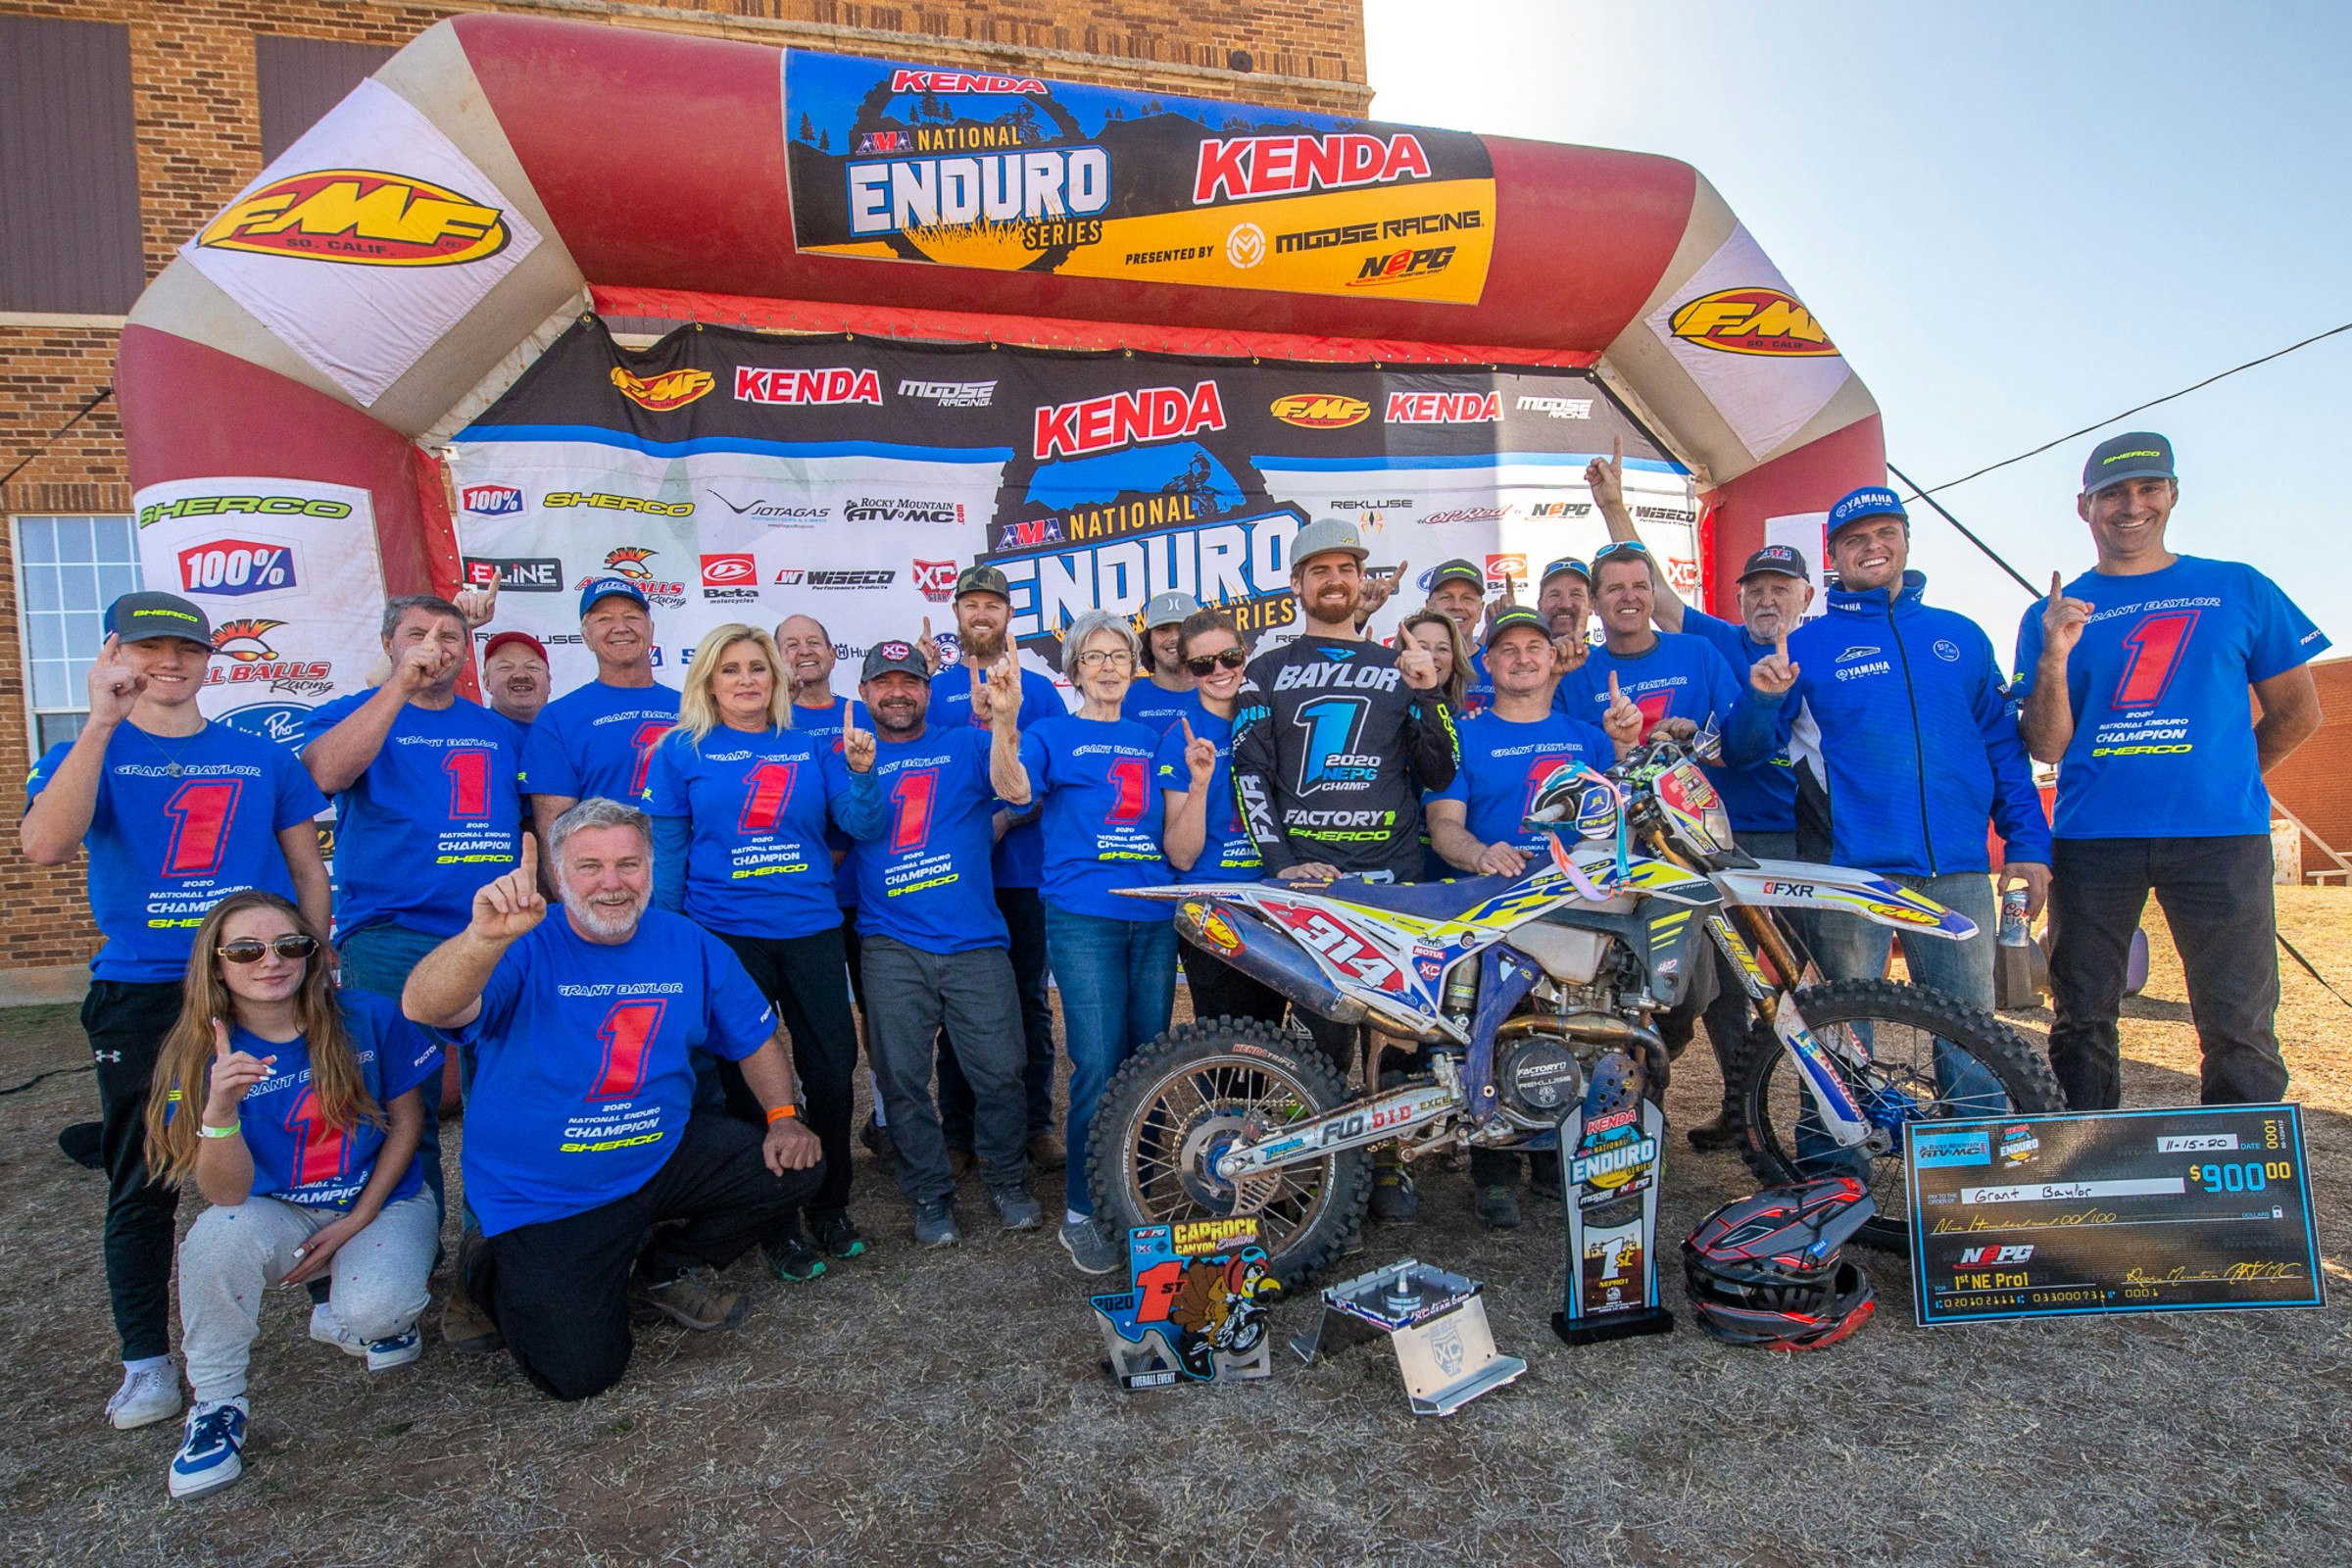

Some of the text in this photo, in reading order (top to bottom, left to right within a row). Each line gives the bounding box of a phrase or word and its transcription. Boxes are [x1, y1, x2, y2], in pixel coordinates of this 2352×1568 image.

[892, 70, 1048, 95] KENDA
[857, 125, 1022, 153] AMA NATIONAL
[1193, 133, 1432, 204] KENDA
[848, 147, 1109, 234] ENDURO
[198, 182, 503, 248] FMF
[1026, 220, 1101, 248] SERIES
[1276, 210, 1482, 254] MOOSE RACING
[285, 238, 394, 258] SO. CALIF.
[1125, 246, 1214, 266] PRESENTED BY
[1671, 299, 1831, 345] FM
[734, 365, 883, 407] KENDA
[898, 379, 999, 399] MOOSE
[937, 397, 991, 408] RACING
[1271, 397, 1371, 421] FMF
[1384, 390, 1505, 424] KENDA
[1515, 396, 1595, 413] MOOSE
[1032, 378, 1227, 461] KENDA
[2103, 450, 2161, 466] SHERCO
[467, 490, 518, 512] 100%
[543, 492, 696, 517] SHERCO
[860, 497, 955, 511] ROCKY MOUNTAIN
[1330, 499, 1413, 510] REKLUSE
[1845, 493, 1893, 510] YAMAHA
[139, 495, 353, 530] SHERCO
[751, 507, 831, 517] JOTAGAS
[996, 494, 1196, 551] AMA NATIONAL
[186, 549, 285, 589] 100%
[912, 563, 958, 590] XC
[988, 514, 1301, 639] ENDURO
[703, 588, 759, 599] Beta
[2143, 597, 2222, 612] BAYLOR
[133, 609, 198, 623] SHERCO
[1847, 661, 1890, 676] YAMAHA
[2112, 610, 2201, 710] 1
[228, 662, 332, 684] BALLS
[1273, 662, 1401, 694] BAYLOR
[269, 677, 335, 697] Racing
[593, 710, 638, 726] GRANT
[2099, 717, 2188, 730] NATIONAL ENDURO
[2095, 728, 2187, 744] CHAMPION
[1293, 694, 1372, 799] 1
[2091, 743, 2193, 758] SHERCO
[115, 764, 261, 777] GRAN BAYLOR
[1325, 754, 1382, 768] 2020
[1323, 767, 1378, 781] NEPG
[441, 748, 492, 821] 1
[1104, 757, 1150, 825] 1
[1322, 781, 1370, 792] CHAMP
[738, 759, 799, 835] 1
[890, 767, 940, 856] 1
[1240, 773, 1280, 844] FXR
[161, 778, 244, 878] 1
[1288, 827, 1392, 842] SHERCO
[437, 841, 511, 852] CHAMPION
[436, 855, 514, 864] SHERCO
[732, 852, 801, 866] CHAMPION
[885, 854, 952, 874] NATIONAL ENDURO
[731, 863, 808, 879] SHERCO
[885, 862, 953, 886] CHAMPION
[887, 873, 959, 898] SHERCO
[1667, 881, 1709, 893] FACTORY
[1774, 883, 1813, 898] FXR
[147, 899, 224, 913] CHAMP
[1869, 903, 1941, 926] FMF
[148, 918, 205, 929] SHE
[1292, 914, 1397, 989] 314
[1414, 947, 1446, 959] MOTUL
[616, 982, 683, 995] BAYLOR
[585, 999, 667, 1102] 1
[1232, 1043, 1267, 1057] KENDA
[568, 1106, 661, 1124] NATIONAL ENDURO
[602, 1102, 632, 1112] 2020
[564, 1117, 661, 1139] CHAMPION
[1586, 1108, 1638, 1136] KENDA
[560, 1131, 663, 1152] SHERCO
[2264, 1119, 2278, 1150] 0001
[1592, 1138, 1627, 1152] NATIONAL
[2000, 1139, 2039, 1156] ENDURO
[1572, 1139, 1656, 1183] ENDURO
[1627, 1161, 1653, 1175] SERIES
[1975, 1184, 2092, 1203] Grant Baylor
[1173, 1217, 1260, 1243] CAPROCK
[1175, 1235, 1256, 1253] CANYON Enduro
[1954, 1275, 1969, 1291] 1st
[1972, 1274, 1991, 1290] NE
[1093, 1295, 1135, 1311] 2020
[1130, 1372, 1176, 1388] OVERALL EVENT
